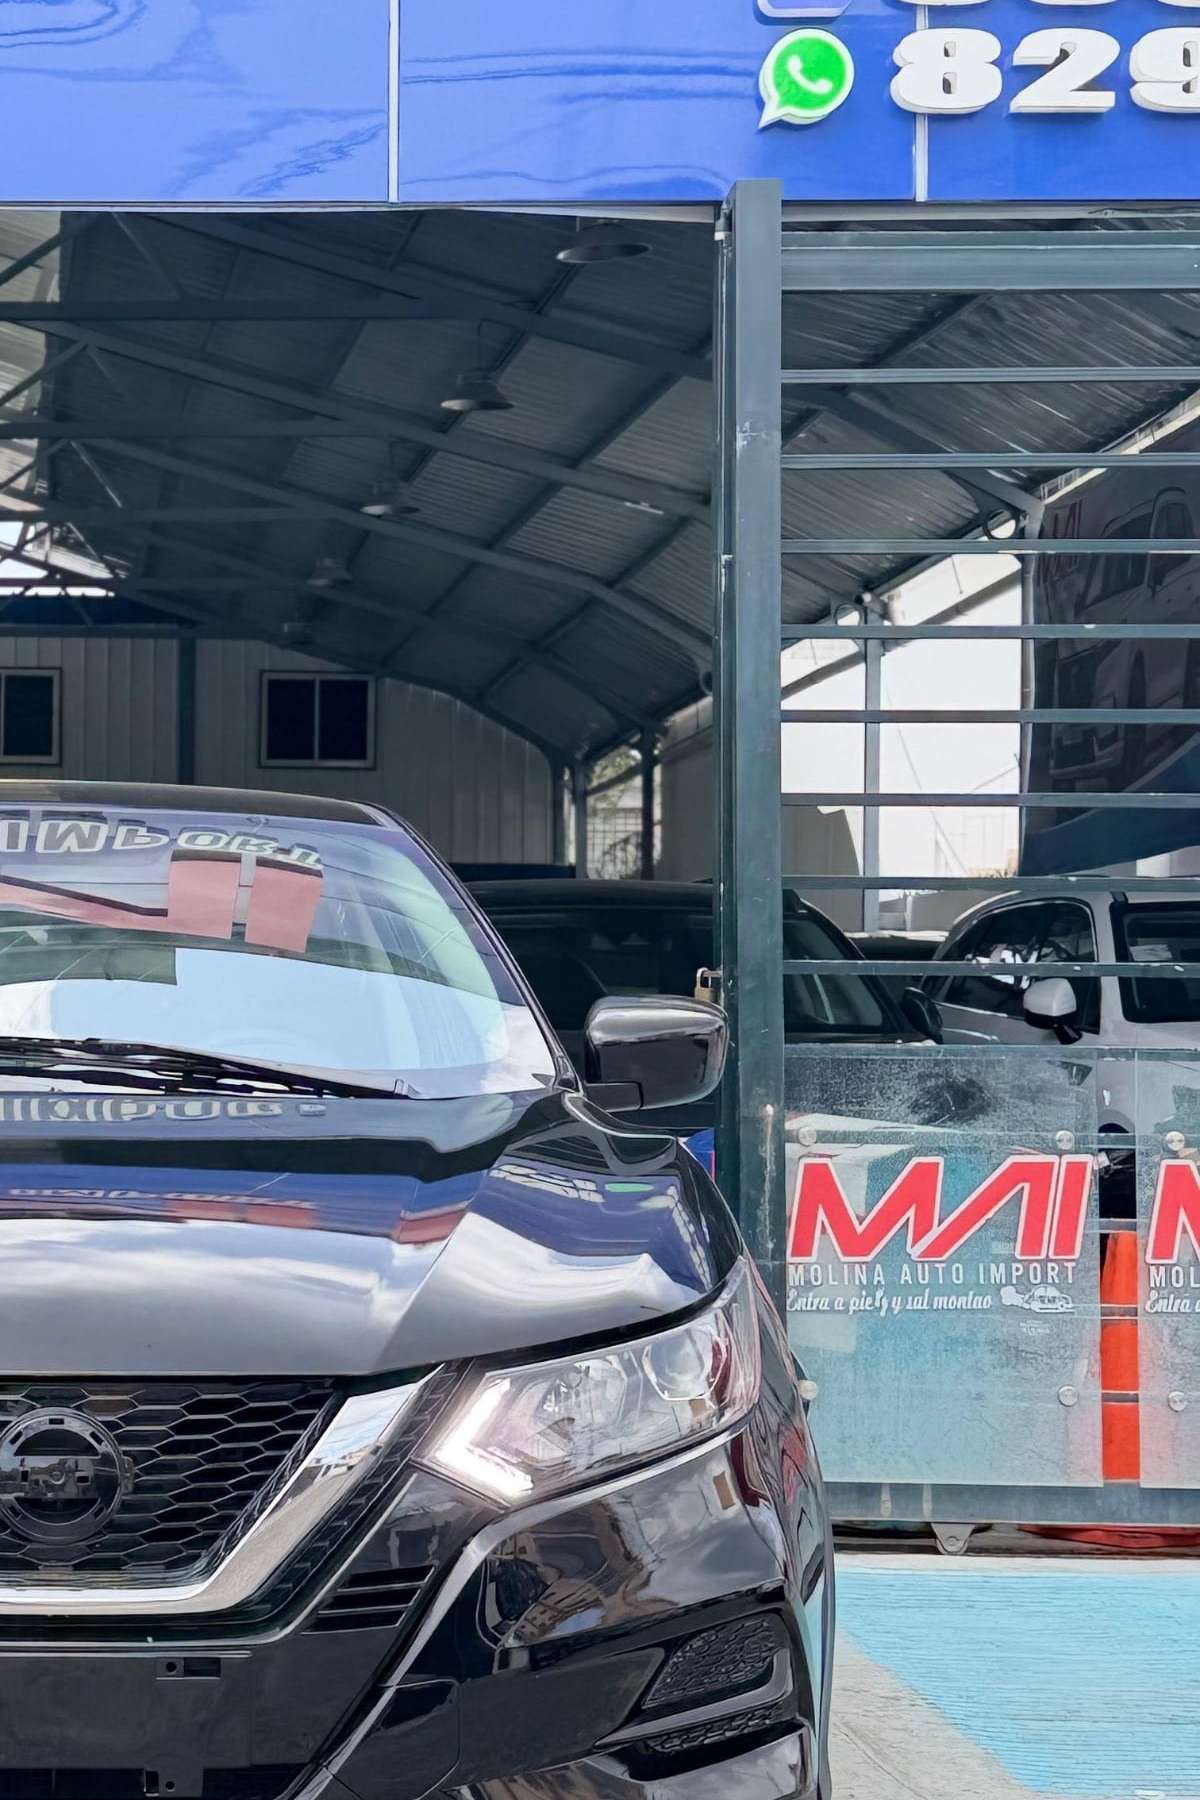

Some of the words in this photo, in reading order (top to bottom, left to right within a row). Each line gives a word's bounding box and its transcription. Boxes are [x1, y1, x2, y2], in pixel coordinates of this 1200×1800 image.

[891, 27, 1200, 114] 829
[788, 1153, 1093, 1263] MAI
[786, 1287, 831, 1312] Entra
[834, 1299, 846, 1311] a
[891, 1298, 902, 1315] y
[905, 1288, 932, 1311] sal
[788, 1263, 886, 1286] MOLINA
[900, 1263, 964, 1285] AUTO
[978, 1262, 1077, 1285] IMPORT
